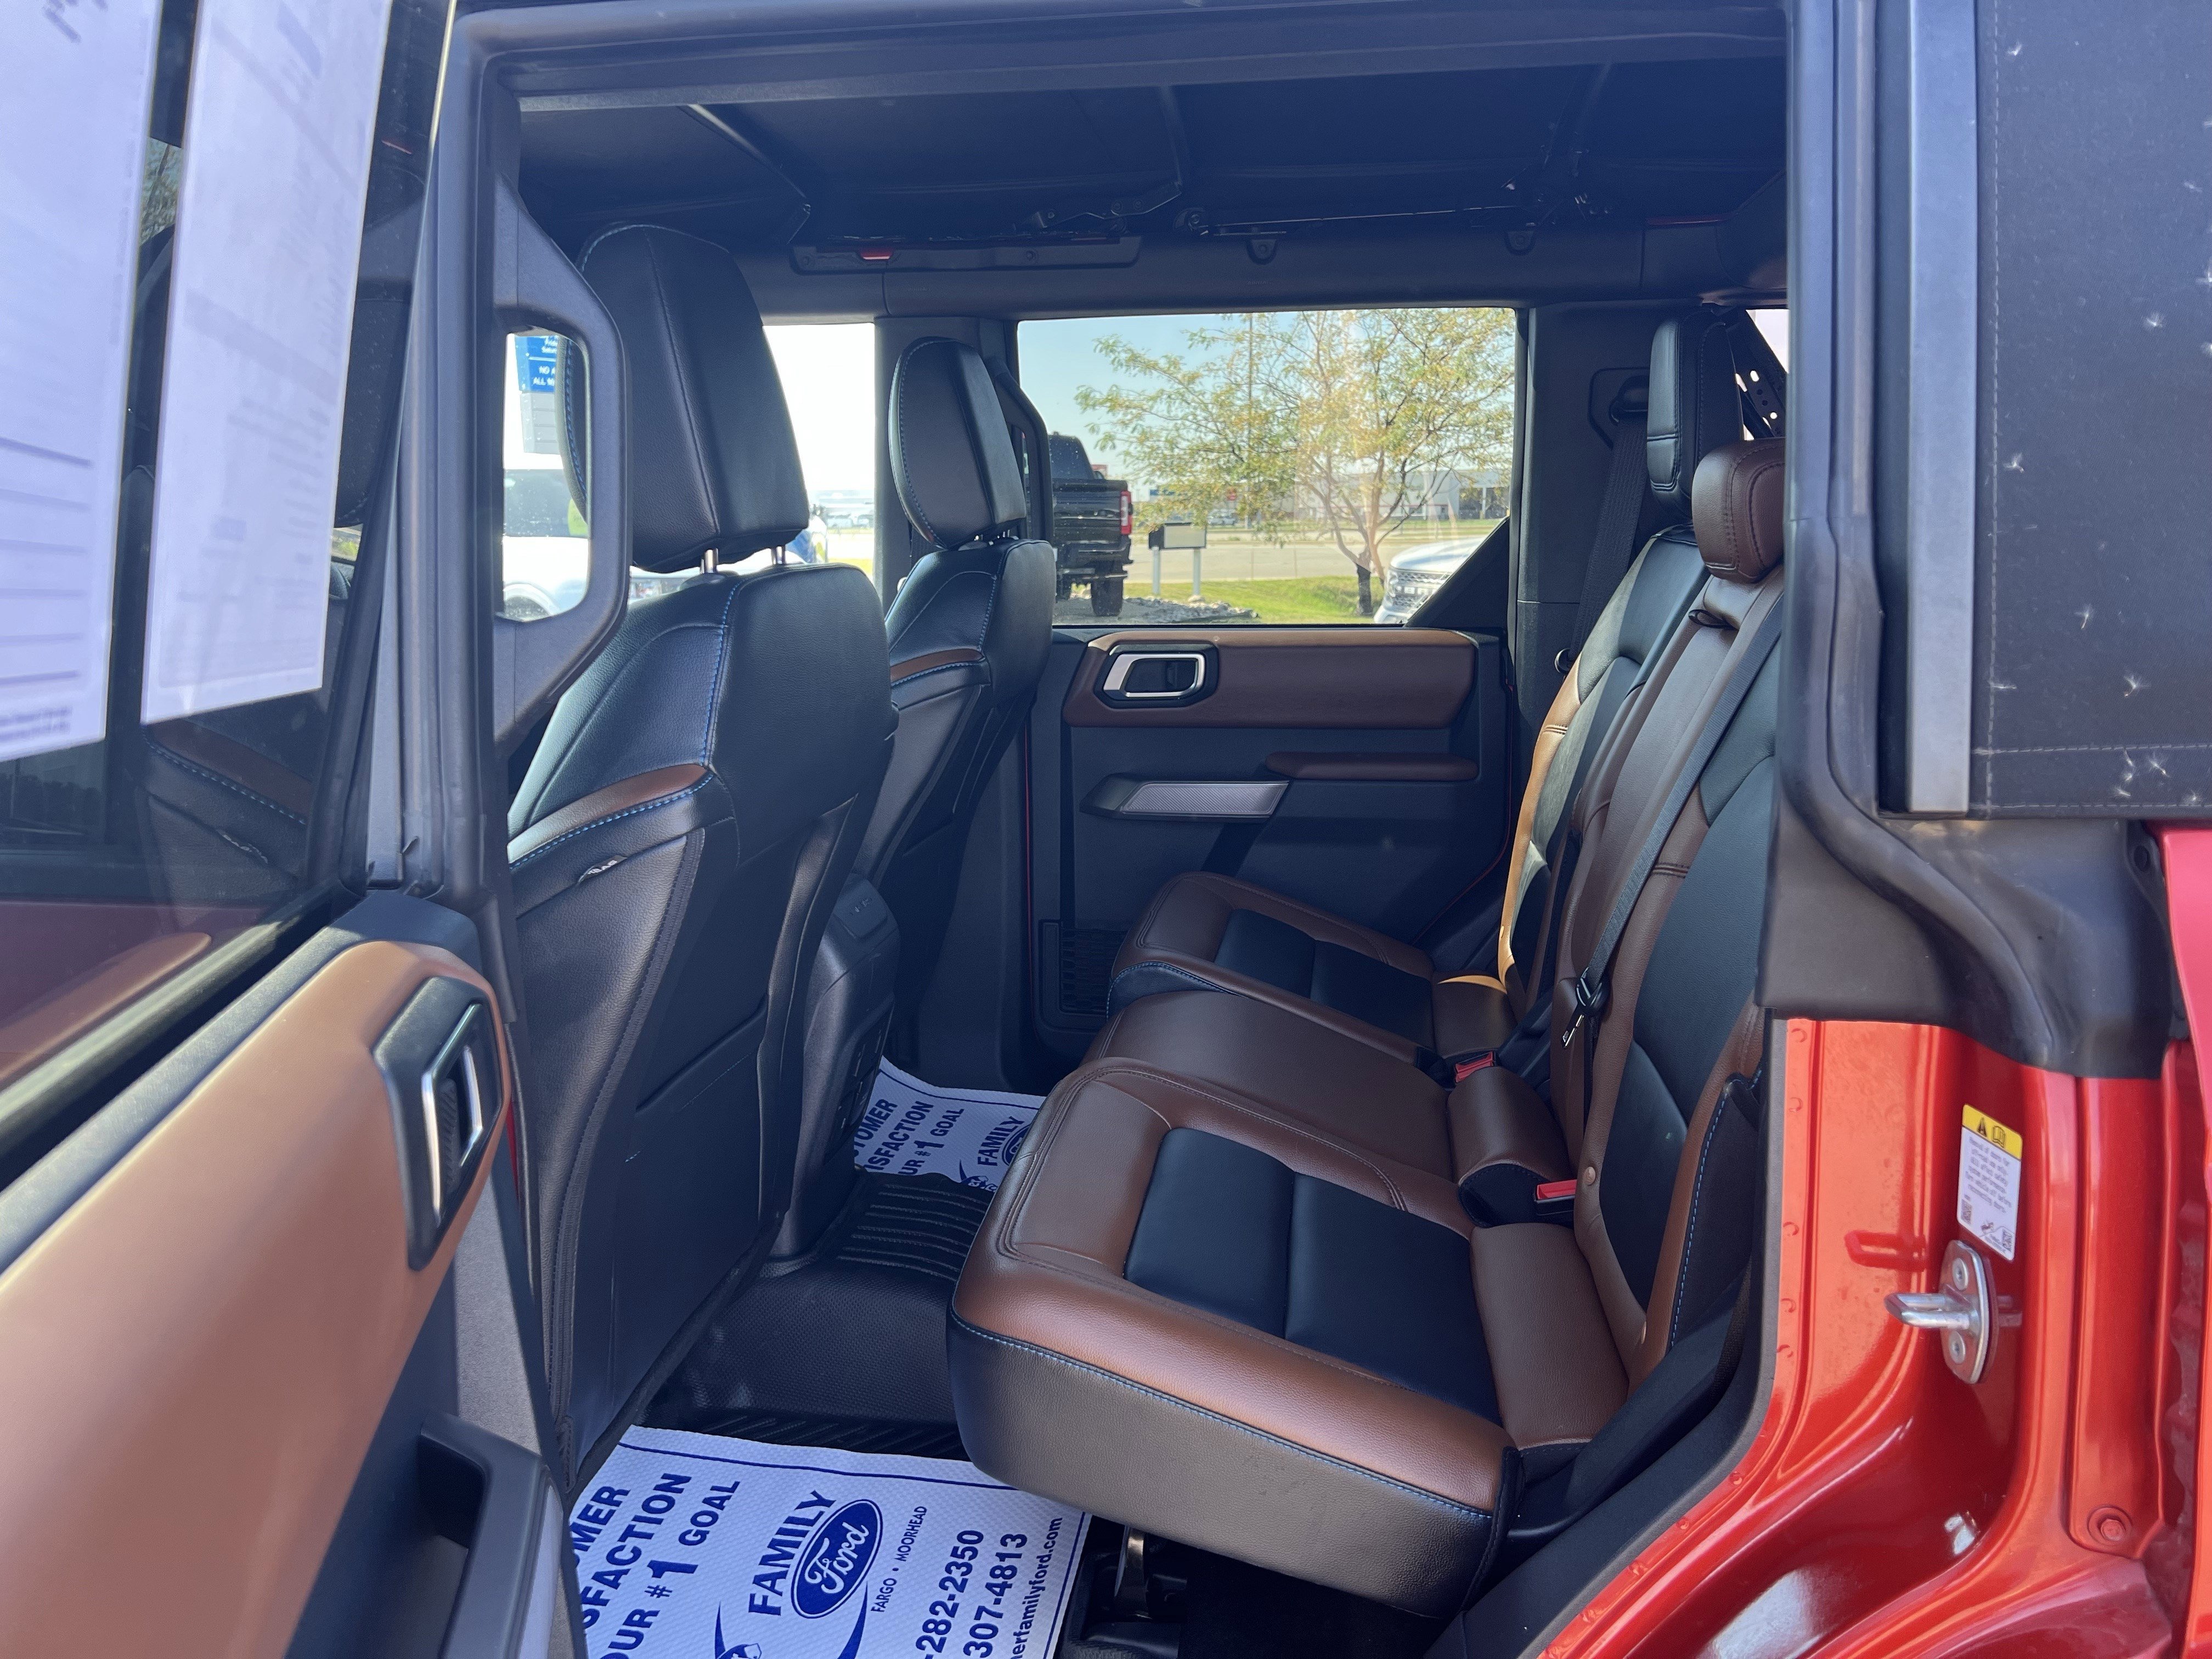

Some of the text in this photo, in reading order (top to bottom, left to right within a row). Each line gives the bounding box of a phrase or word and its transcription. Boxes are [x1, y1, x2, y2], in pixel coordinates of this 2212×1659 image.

[854, 1099, 898, 1158] OMER
[864, 1101, 934, 1171] ISFACTION
[930, 1108, 964, 1137] GOAL
[978, 1116, 1025, 1166] FAMILY
[569, 1486, 631, 1567] MER
[678, 1481, 741, 1546] GOAL
[748, 1489, 837, 1616] FAMILY
[804, 1521, 870, 1594] Ford
[870, 1505, 928, 1613] FARGO MOORHEAD
[962, 1533, 1028, 1658] 307-4813
